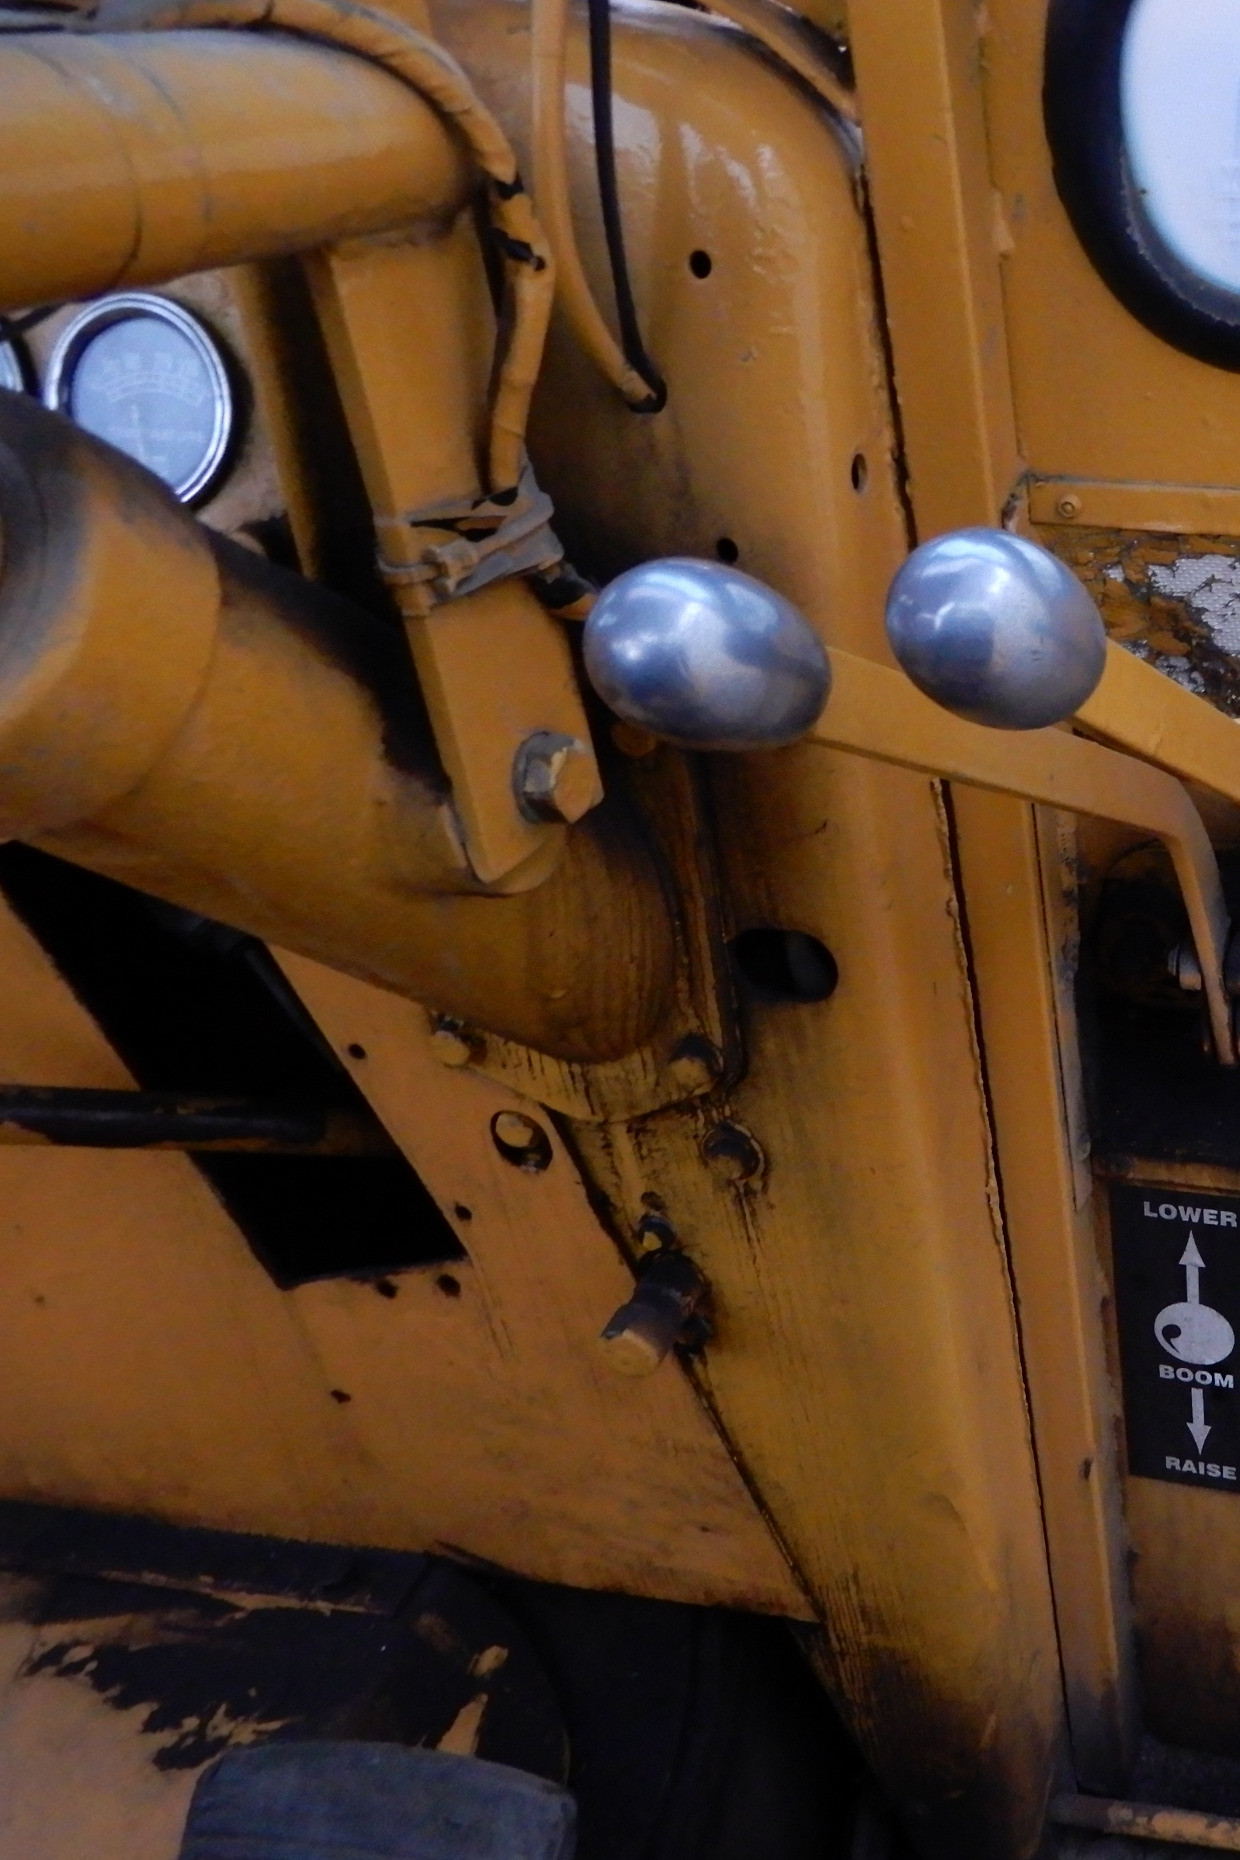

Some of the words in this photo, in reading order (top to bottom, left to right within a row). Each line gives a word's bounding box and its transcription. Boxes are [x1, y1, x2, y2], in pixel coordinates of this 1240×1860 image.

[1143, 1201, 1238, 1228] LOWER
[1158, 1364, 1234, 1389] BOOM
[1165, 1456, 1237, 1480] RAISE
